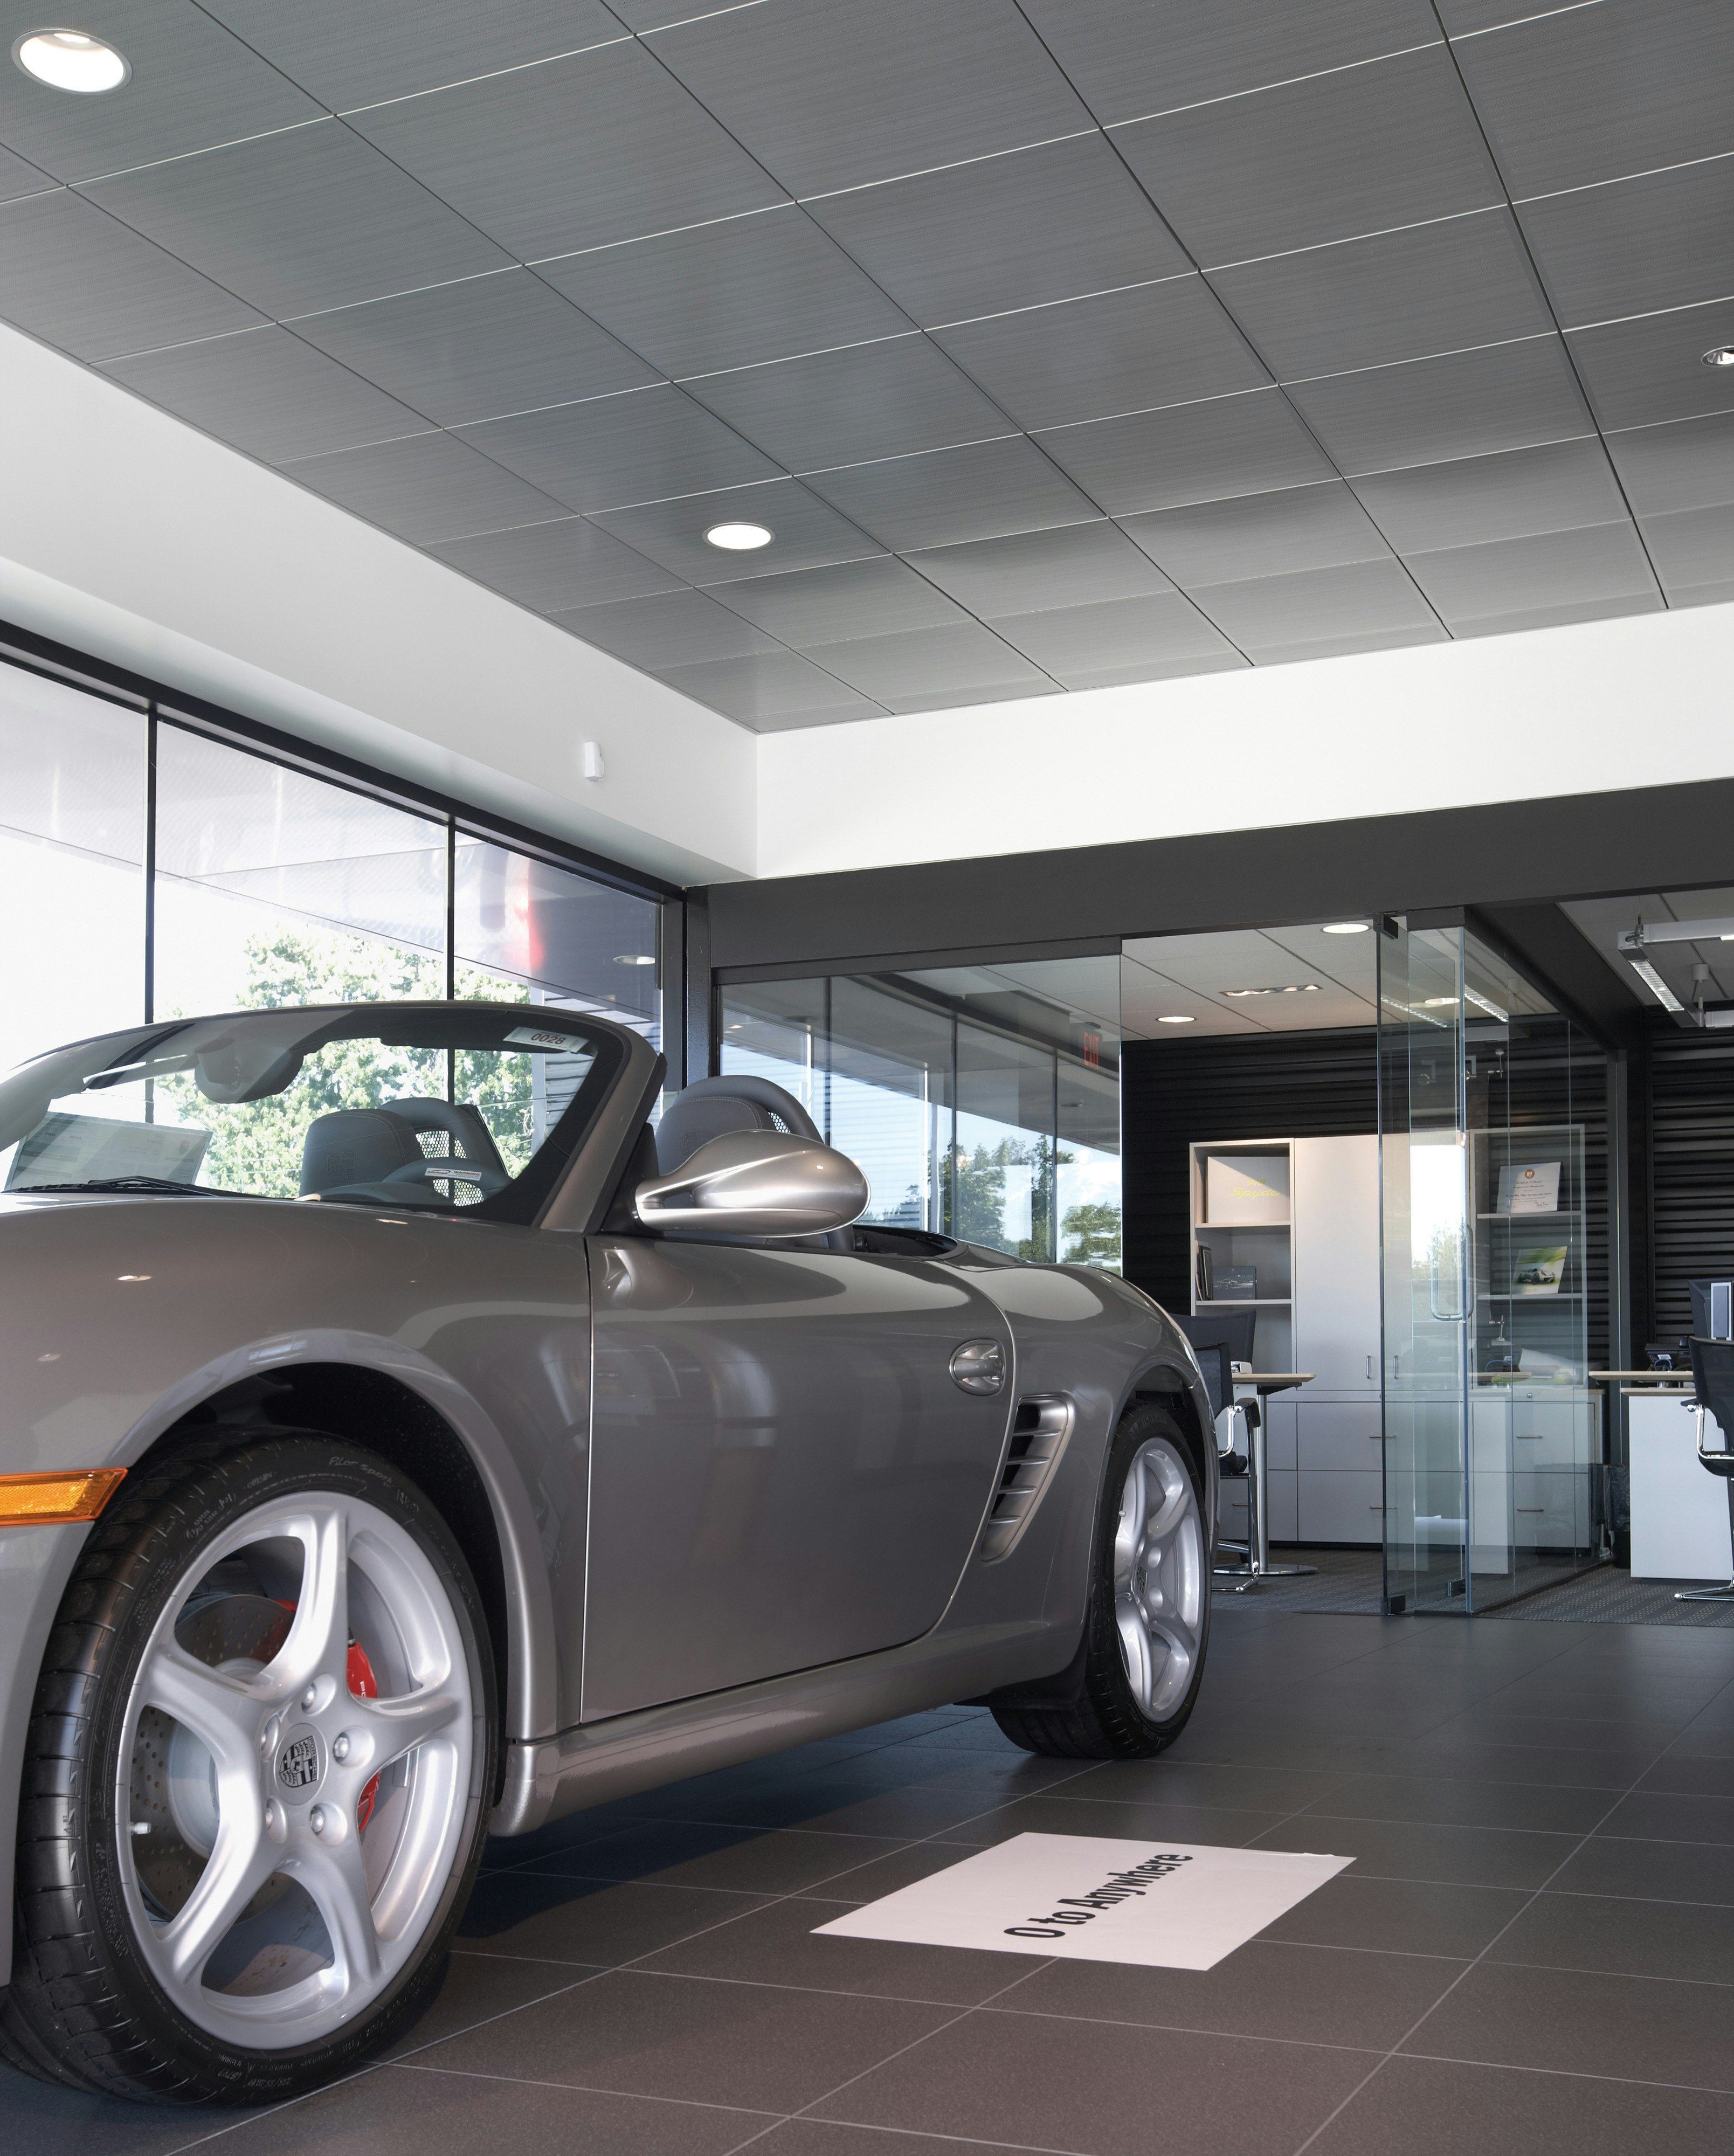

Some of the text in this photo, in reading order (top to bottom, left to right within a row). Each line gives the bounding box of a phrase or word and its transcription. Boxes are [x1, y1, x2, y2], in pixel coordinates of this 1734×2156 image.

[531, 1033, 566, 1045] 0028
[1084, 1032, 1099, 1070] EXIT
[1226, 1187, 1285, 1200] Spyder
[360, 1464, 393, 1483] Sport
[1057, 1853, 1193, 1910] Anywhere
[1027, 1911, 1096, 1925] to
